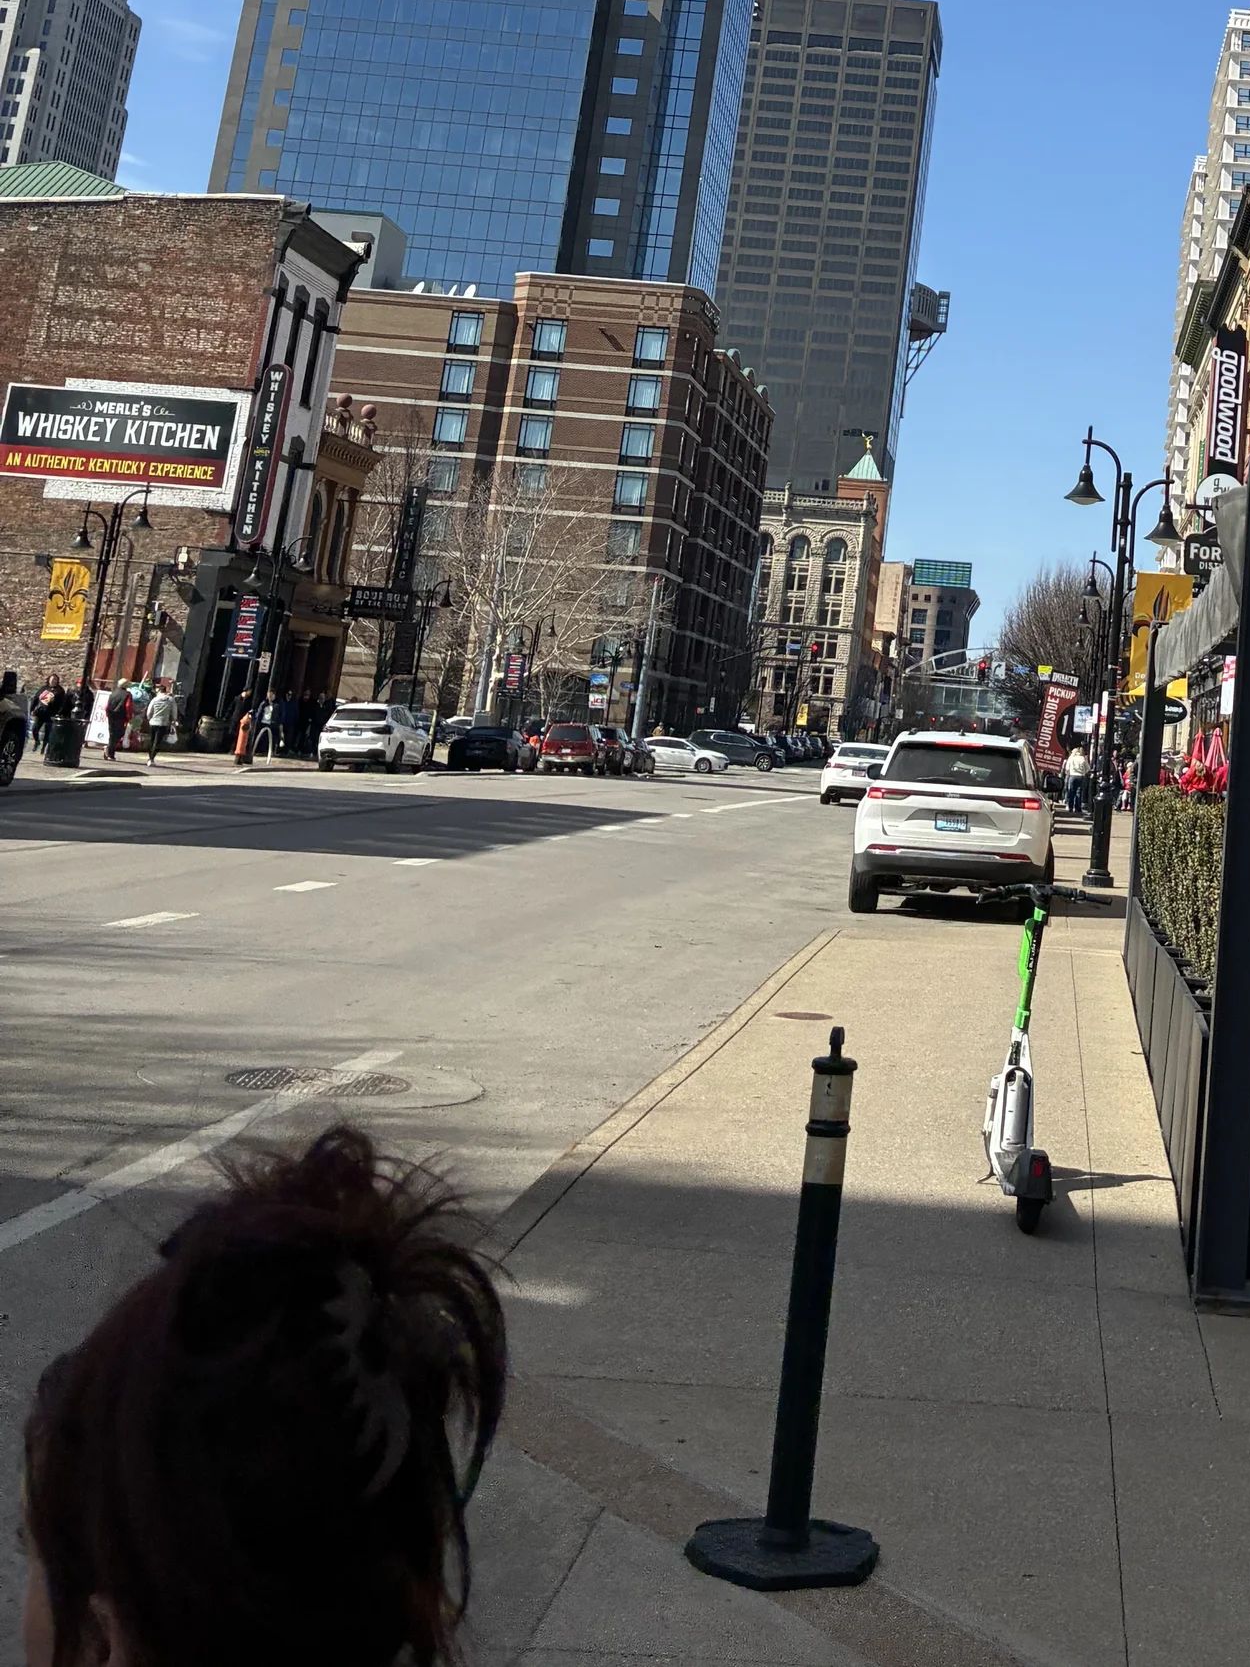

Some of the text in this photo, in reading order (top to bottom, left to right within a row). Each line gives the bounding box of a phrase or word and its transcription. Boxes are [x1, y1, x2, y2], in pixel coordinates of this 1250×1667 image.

[94, 400, 152, 417] MERLE'S
[260, 371, 284, 444] WHISKEY
[1210, 346, 1246, 464] goodwood
[17, 411, 221, 451] WHISKEY KITCHEN
[5, 452, 216, 481] AN AUTHENTIC KENTUCKY EXPERIENCE
[242, 460, 263, 535] KITCHEN
[1048, 686, 1076, 700] PICKUP
[1038, 695, 1060, 748] CURBSIDE
